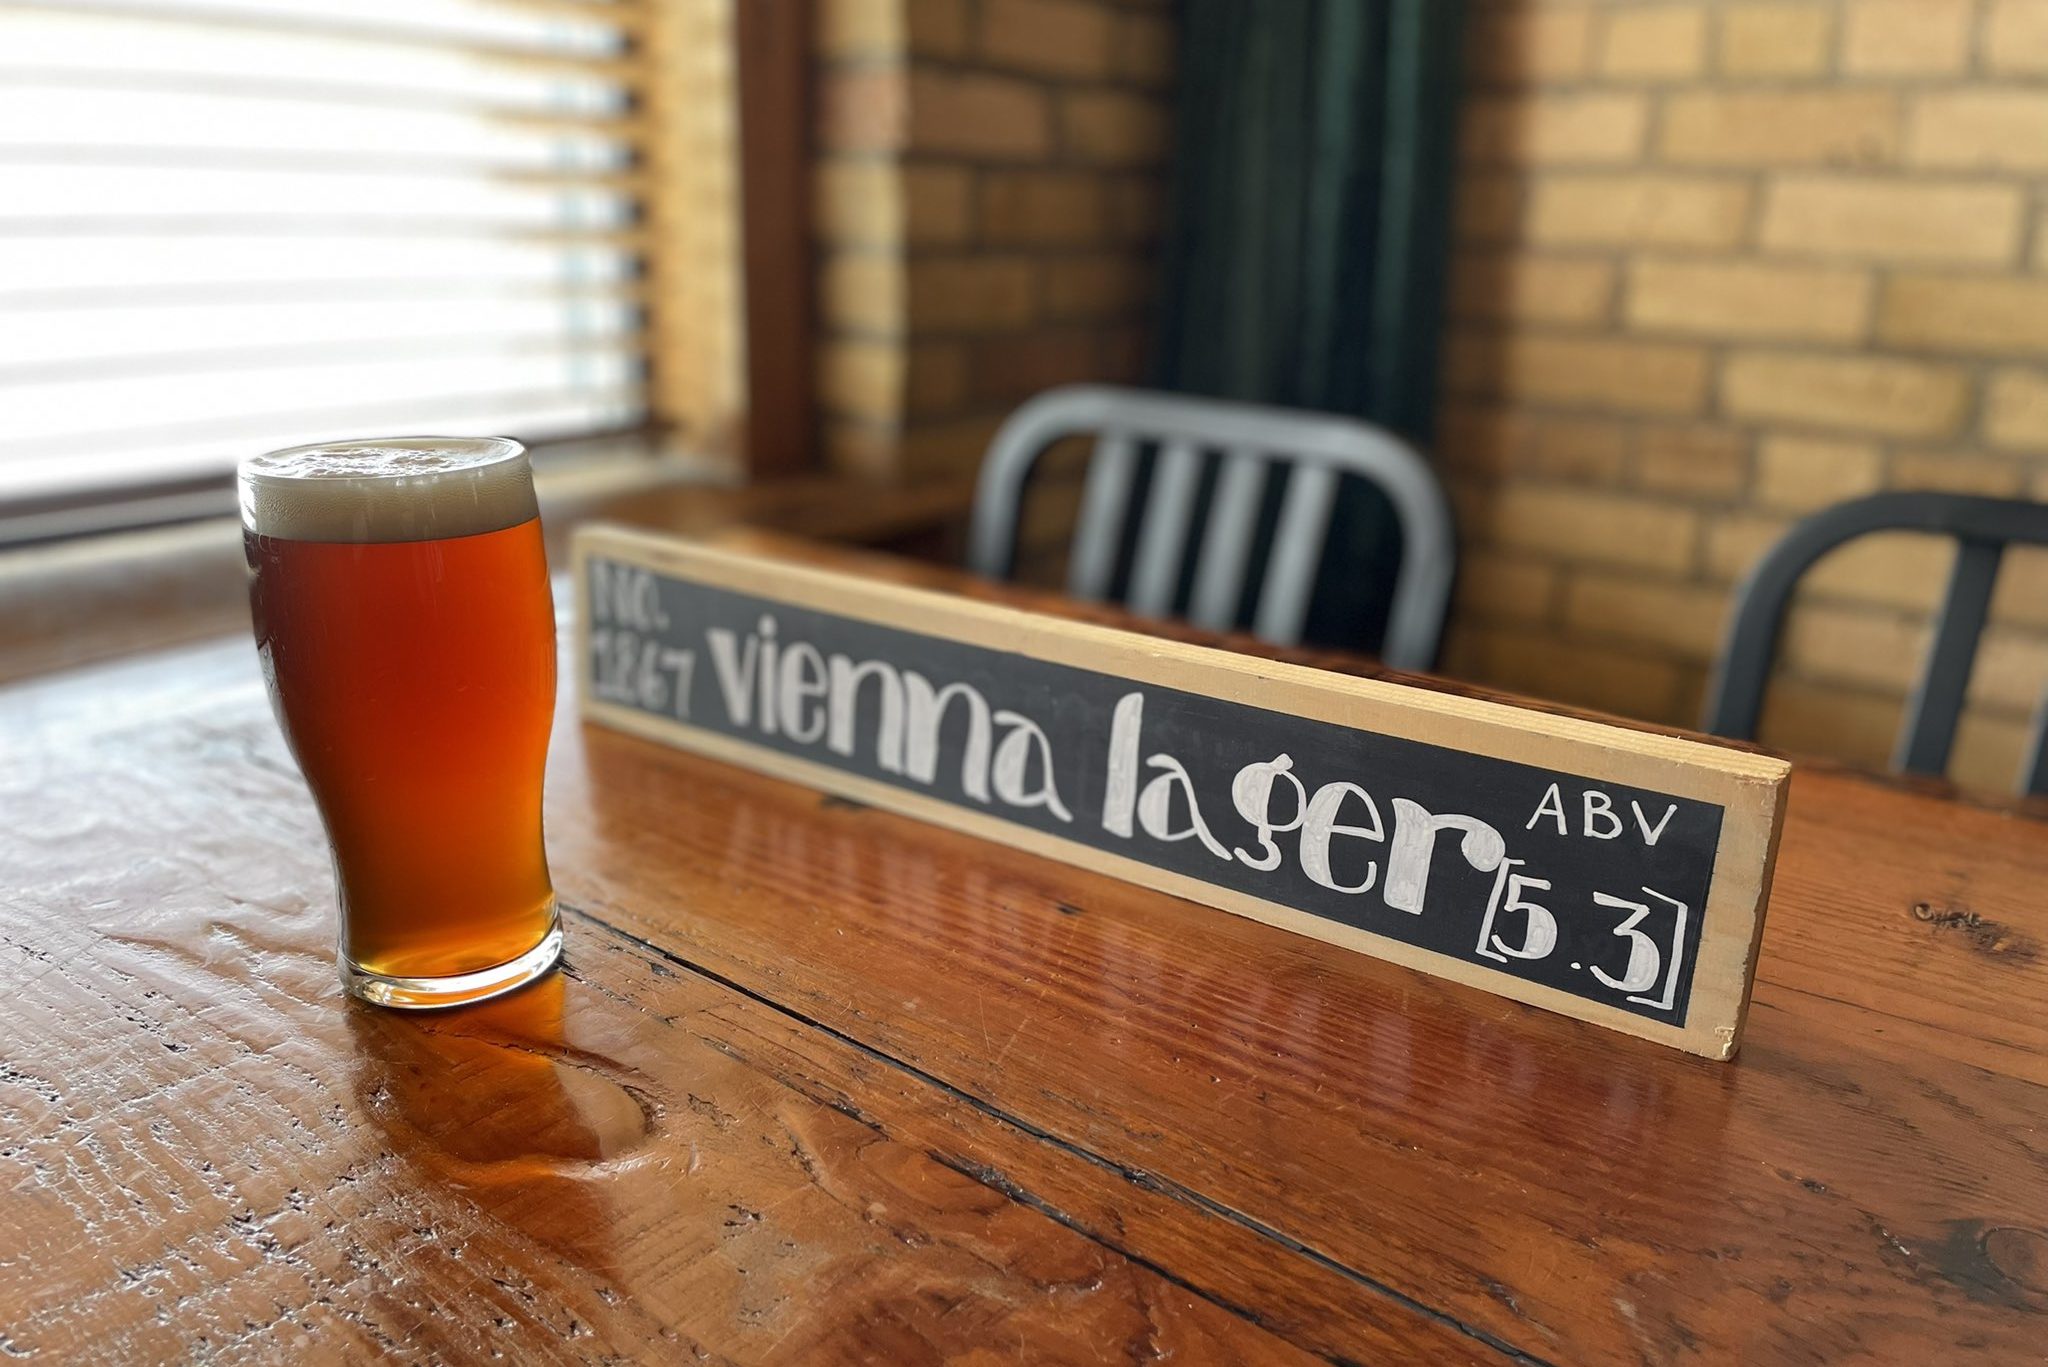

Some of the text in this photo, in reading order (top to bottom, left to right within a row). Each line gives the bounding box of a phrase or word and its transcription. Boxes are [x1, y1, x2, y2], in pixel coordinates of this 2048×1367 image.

[592, 627, 696, 721] 1867
[705, 613, 1506, 914] vienna lager
[1525, 783, 1678, 845] ABV
